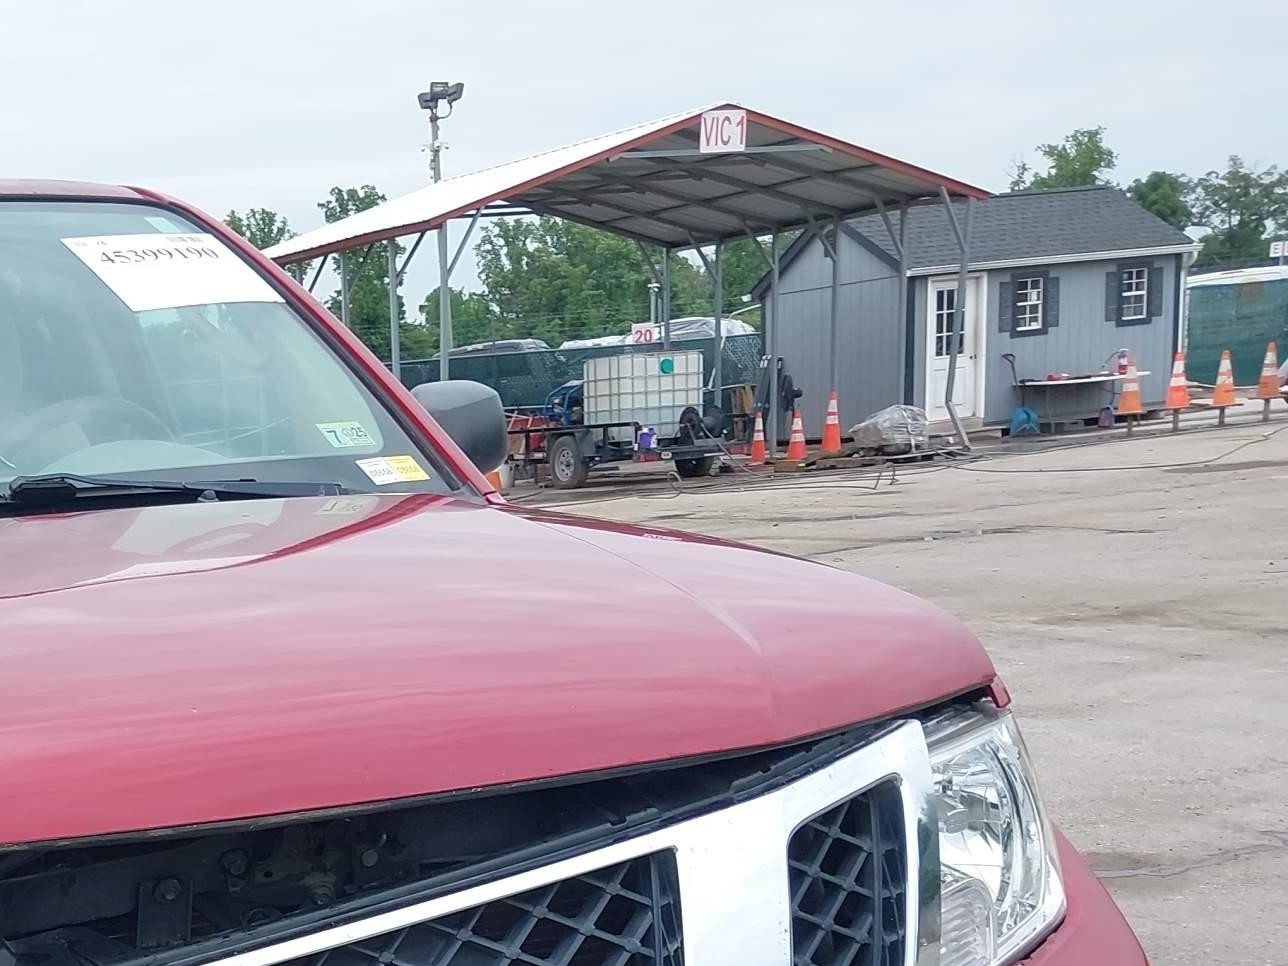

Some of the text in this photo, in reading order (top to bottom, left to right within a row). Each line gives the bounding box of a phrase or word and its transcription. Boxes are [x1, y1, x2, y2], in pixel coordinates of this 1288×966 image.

[703, 115, 745, 146] VIC 1
[100, 246, 220, 265] 45399190
[635, 329, 652, 343] 20
[326, 426, 368, 444] 7 25
